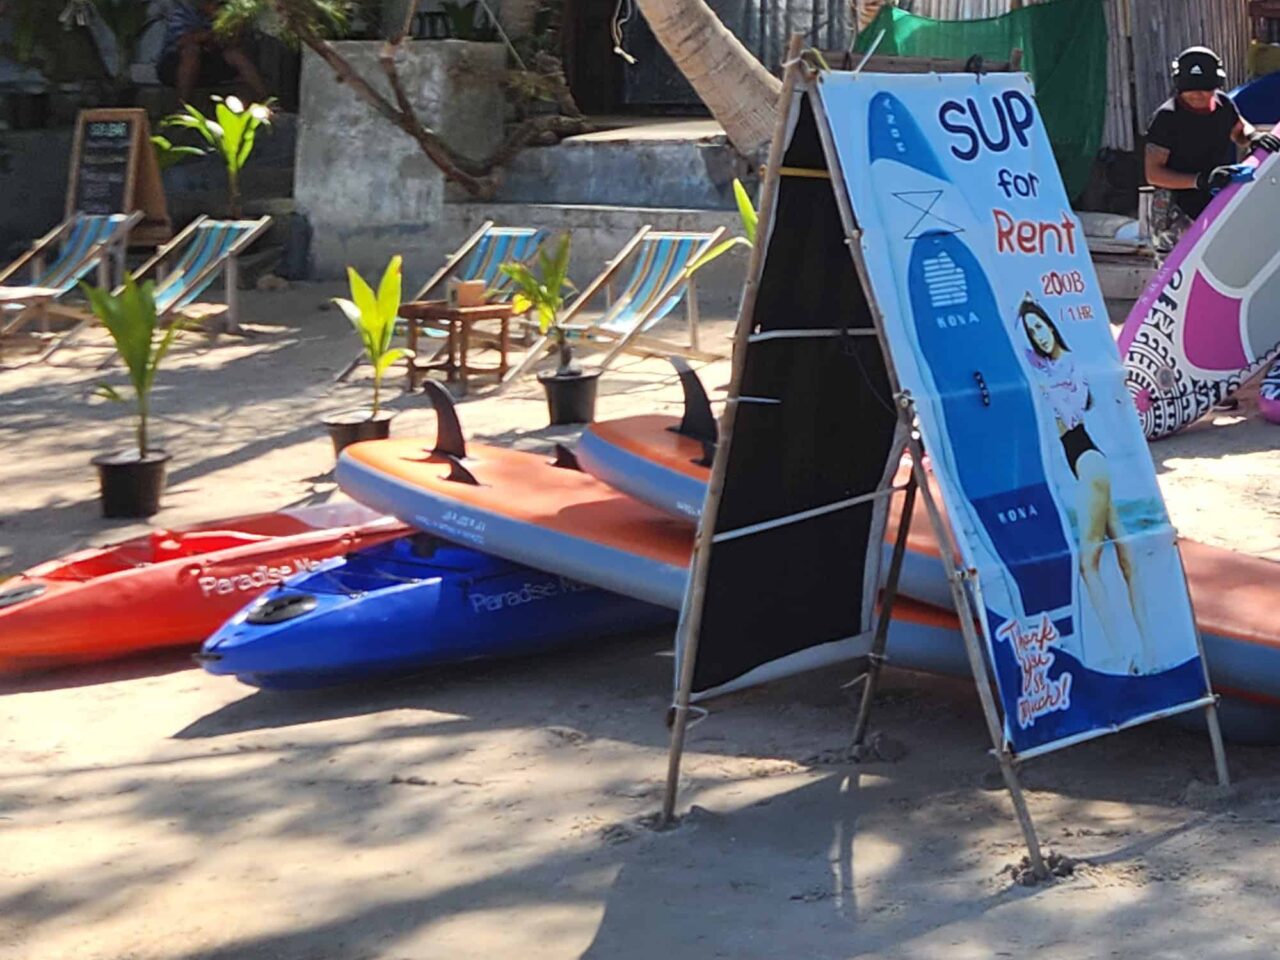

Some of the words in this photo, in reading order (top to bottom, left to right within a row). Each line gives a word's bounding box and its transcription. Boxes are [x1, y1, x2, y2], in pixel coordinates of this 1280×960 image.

[938, 89, 1036, 162] SUP
[997, 168, 1040, 199] for
[993, 208, 1077, 256] Rent
[1041, 270, 1085, 296] 200B
[198, 565, 293, 598] Paradise
[468, 582, 558, 613] Paradise
[998, 614, 1058, 660] Thank
